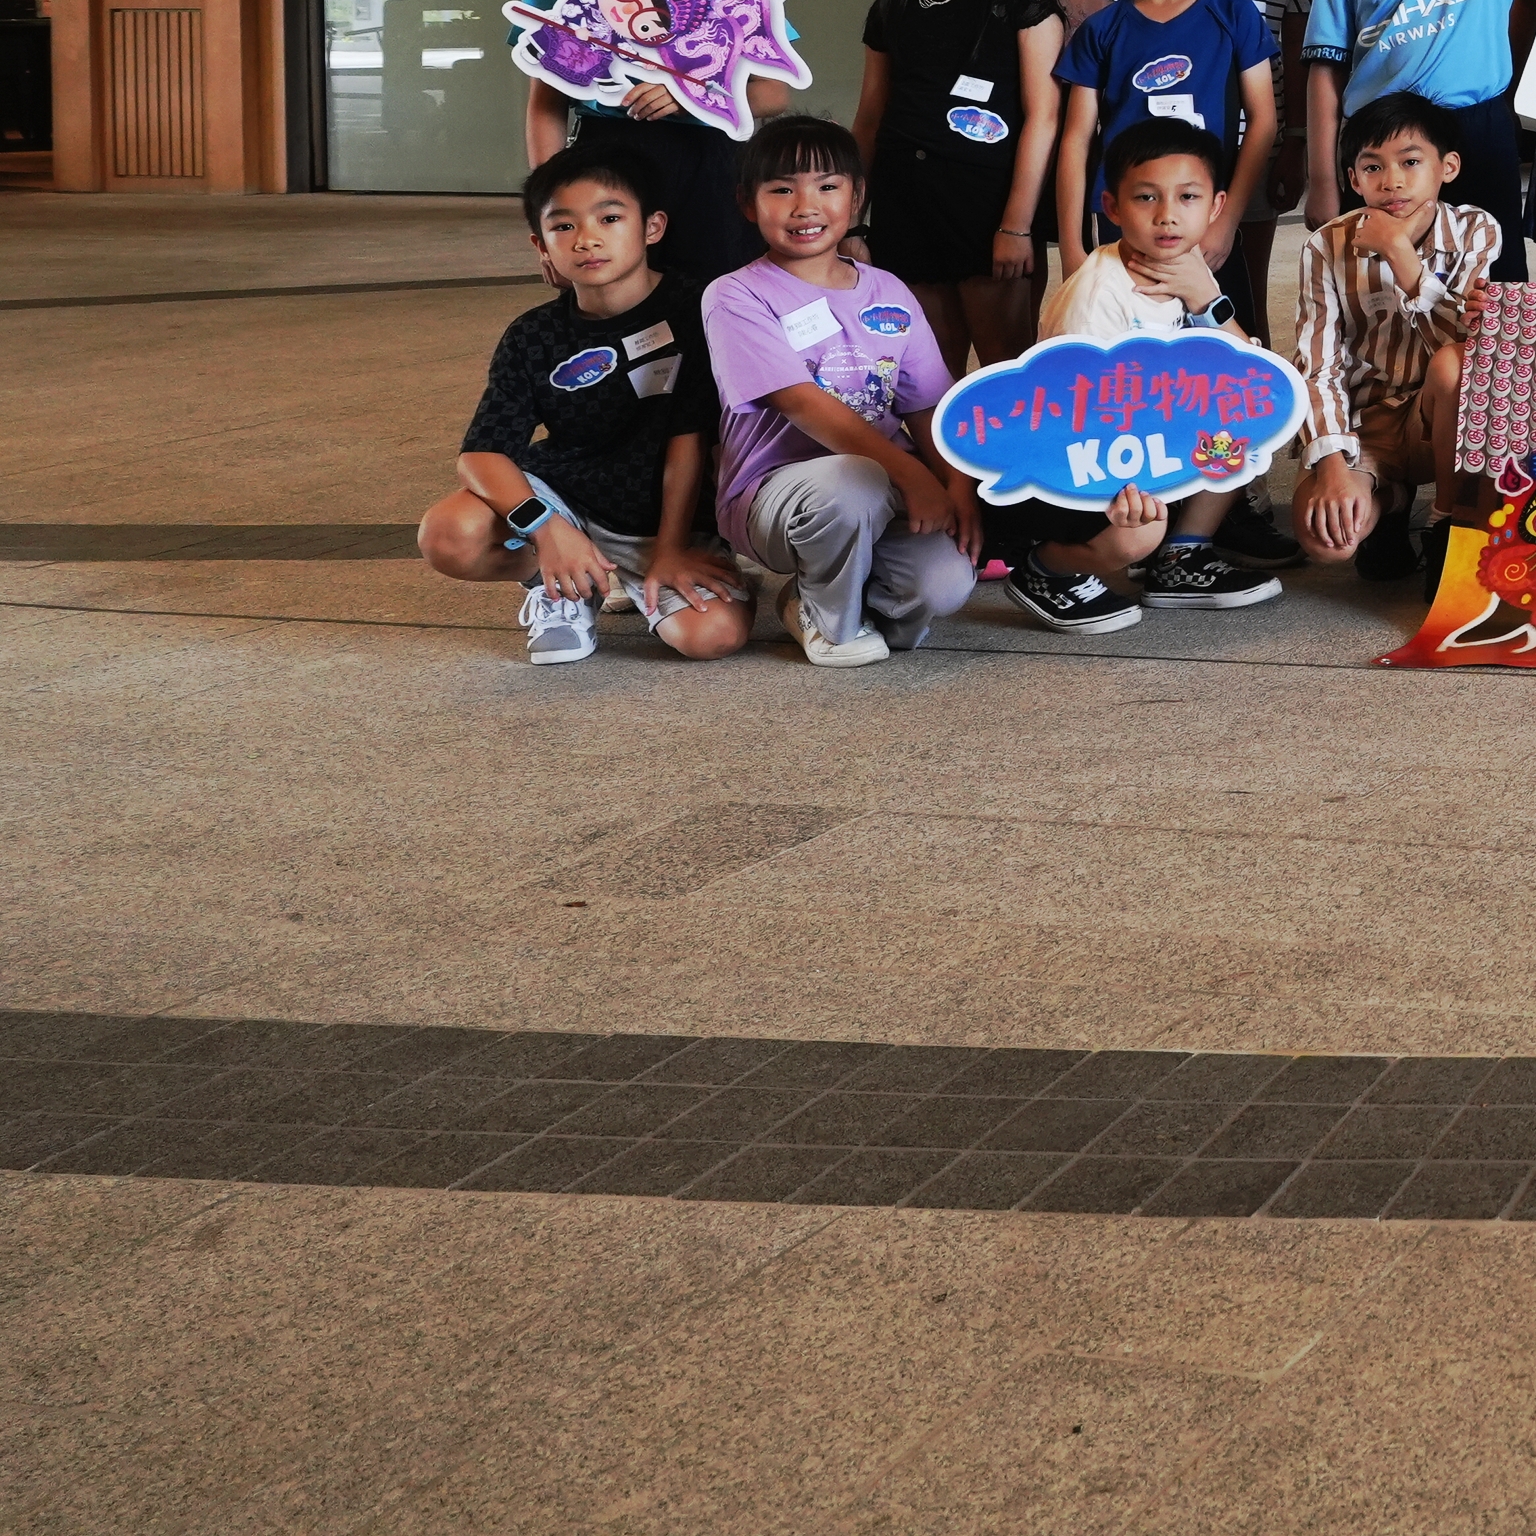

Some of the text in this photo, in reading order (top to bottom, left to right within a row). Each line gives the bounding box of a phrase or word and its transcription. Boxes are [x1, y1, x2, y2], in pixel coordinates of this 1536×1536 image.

[1378, 13, 1455, 53] AIRWAYS
[1155, 74, 1175, 86] KOL
[879, 322, 898, 332] KOL
[575, 369, 600, 385] KOL
[956, 361, 1275, 446] 小小博物館
[1065, 433, 1184, 488] KOL
